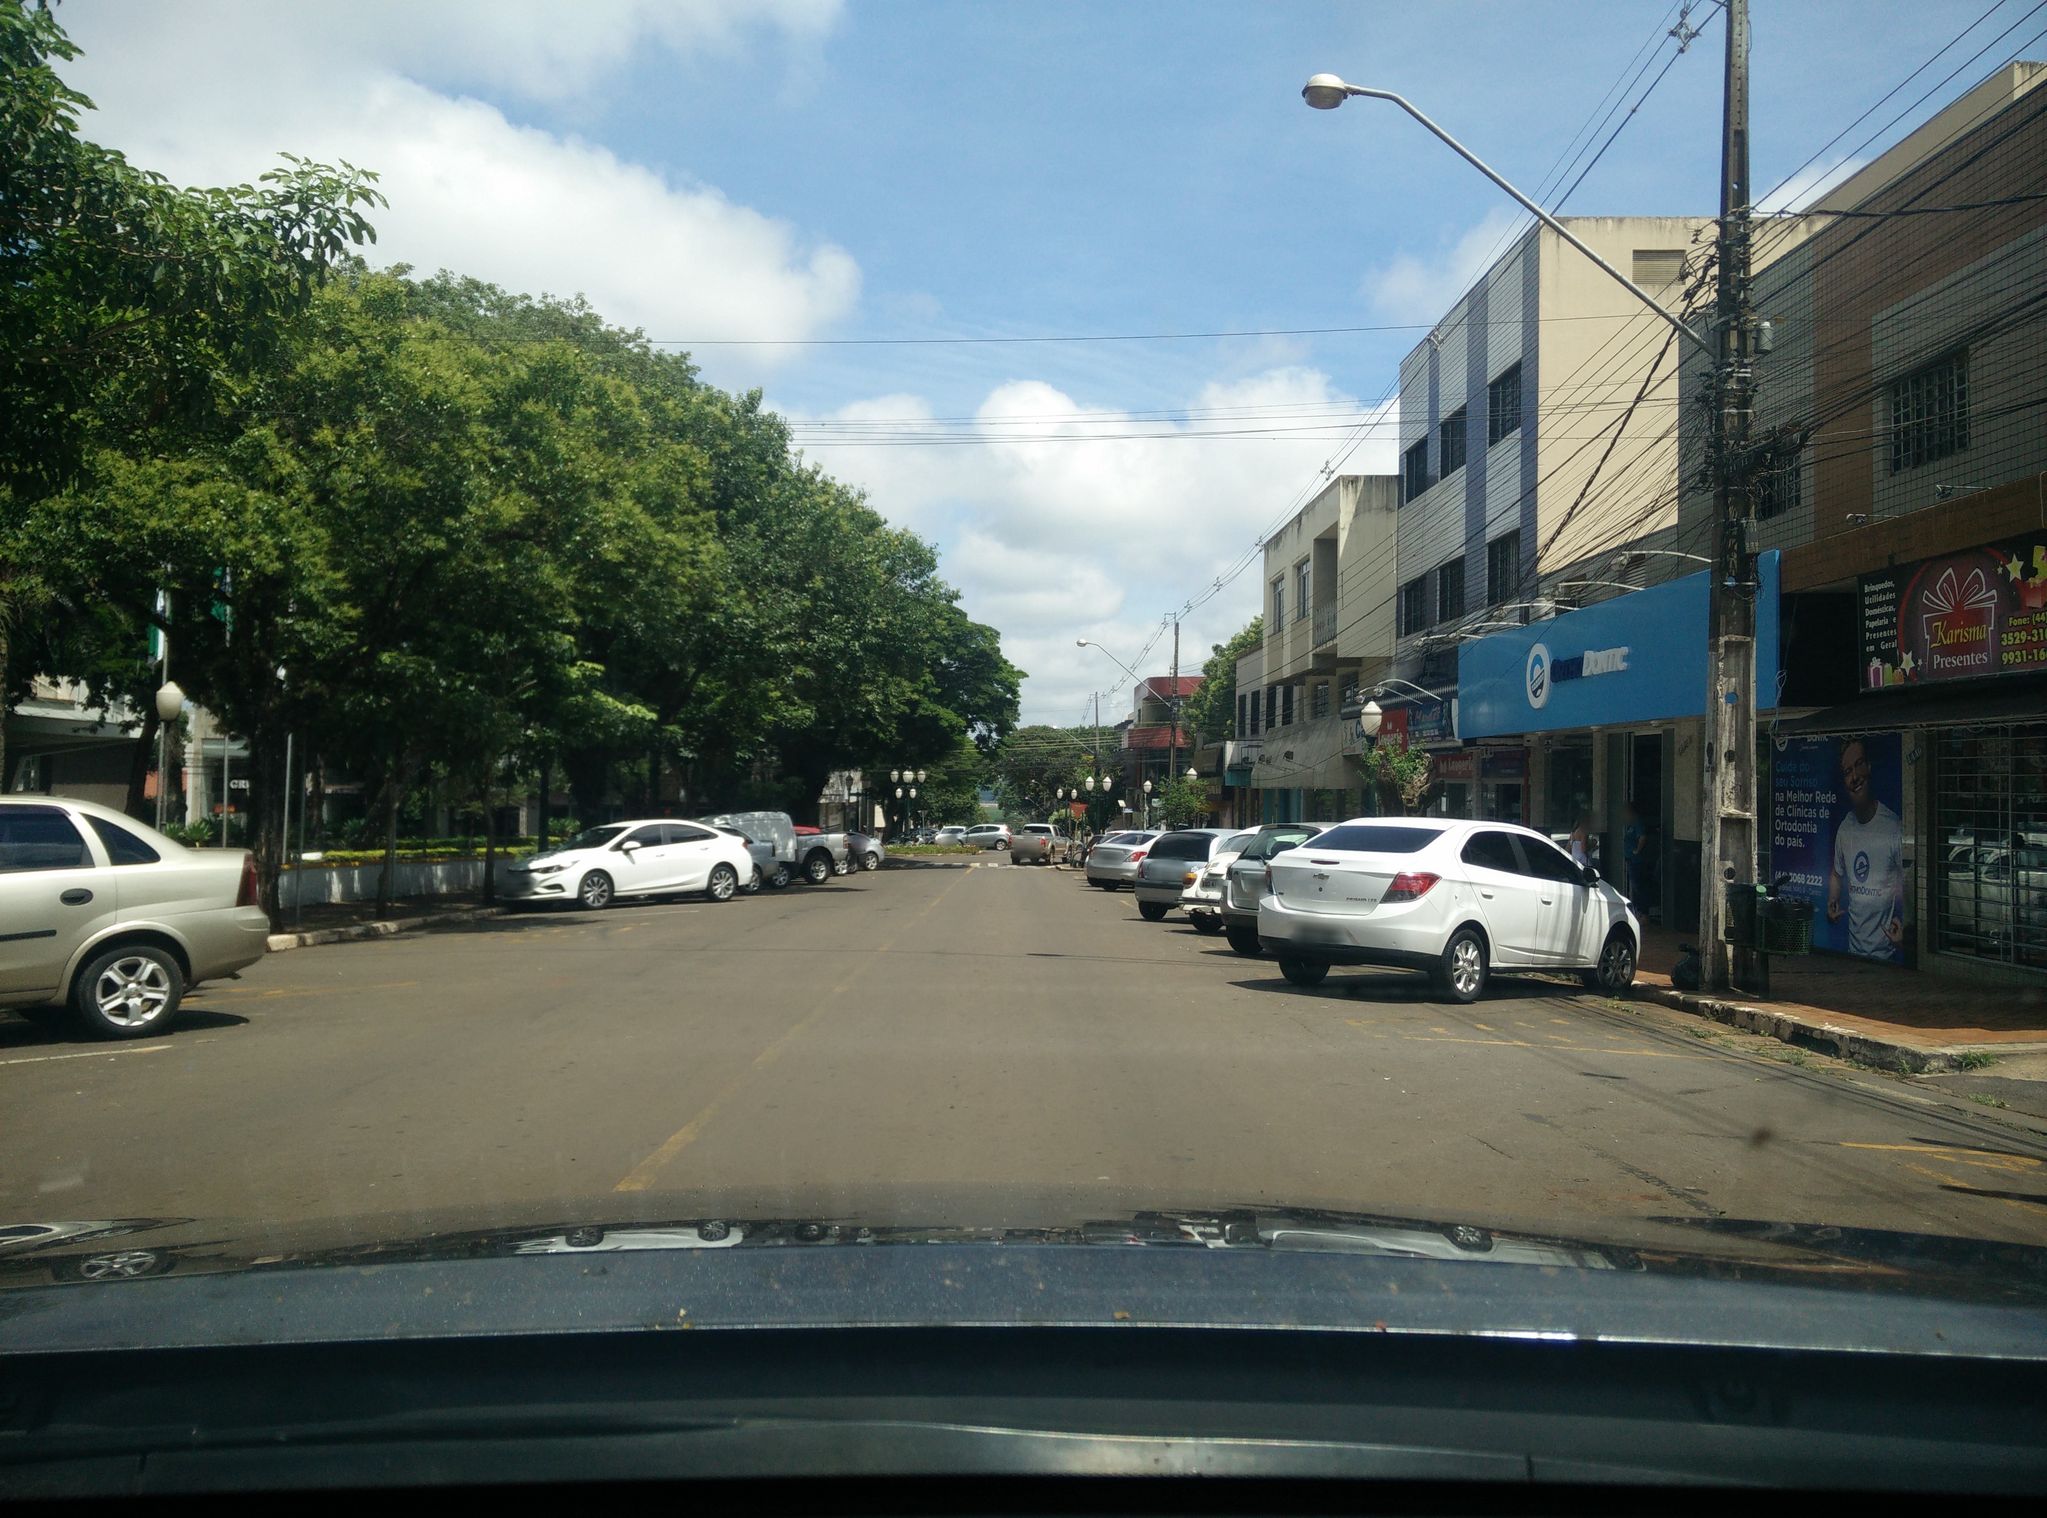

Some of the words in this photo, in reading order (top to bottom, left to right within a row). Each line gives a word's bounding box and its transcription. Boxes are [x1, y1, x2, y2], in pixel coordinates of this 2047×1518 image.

[1865, 592, 1896, 605] Utilidades
[1865, 614, 1889, 629] Papelaria
[2008, 615, 2030, 627] Fone:
[1865, 628, 1897, 641] Presentes
[1930, 621, 1988, 649] Karisma
[1866, 644, 1875, 652] em
[1880, 639, 1897, 650] Geral
[1933, 651, 1988, 670] Presentes
[2002, 648, 2047, 665] 9931-16
[1775, 792, 1785, 802] na
[1786, 790, 1813, 803] Melhor
[1815, 791, 1837, 804] Rede
[1775, 804, 1785, 817] de
[1786, 805, 1817, 819] Clínicas
[1819, 806, 1830, 819] de
[1774, 819, 1818, 834] Ortodontia
[1774, 833, 1785, 846] do
[1806, 874, 1824, 887] 2222
